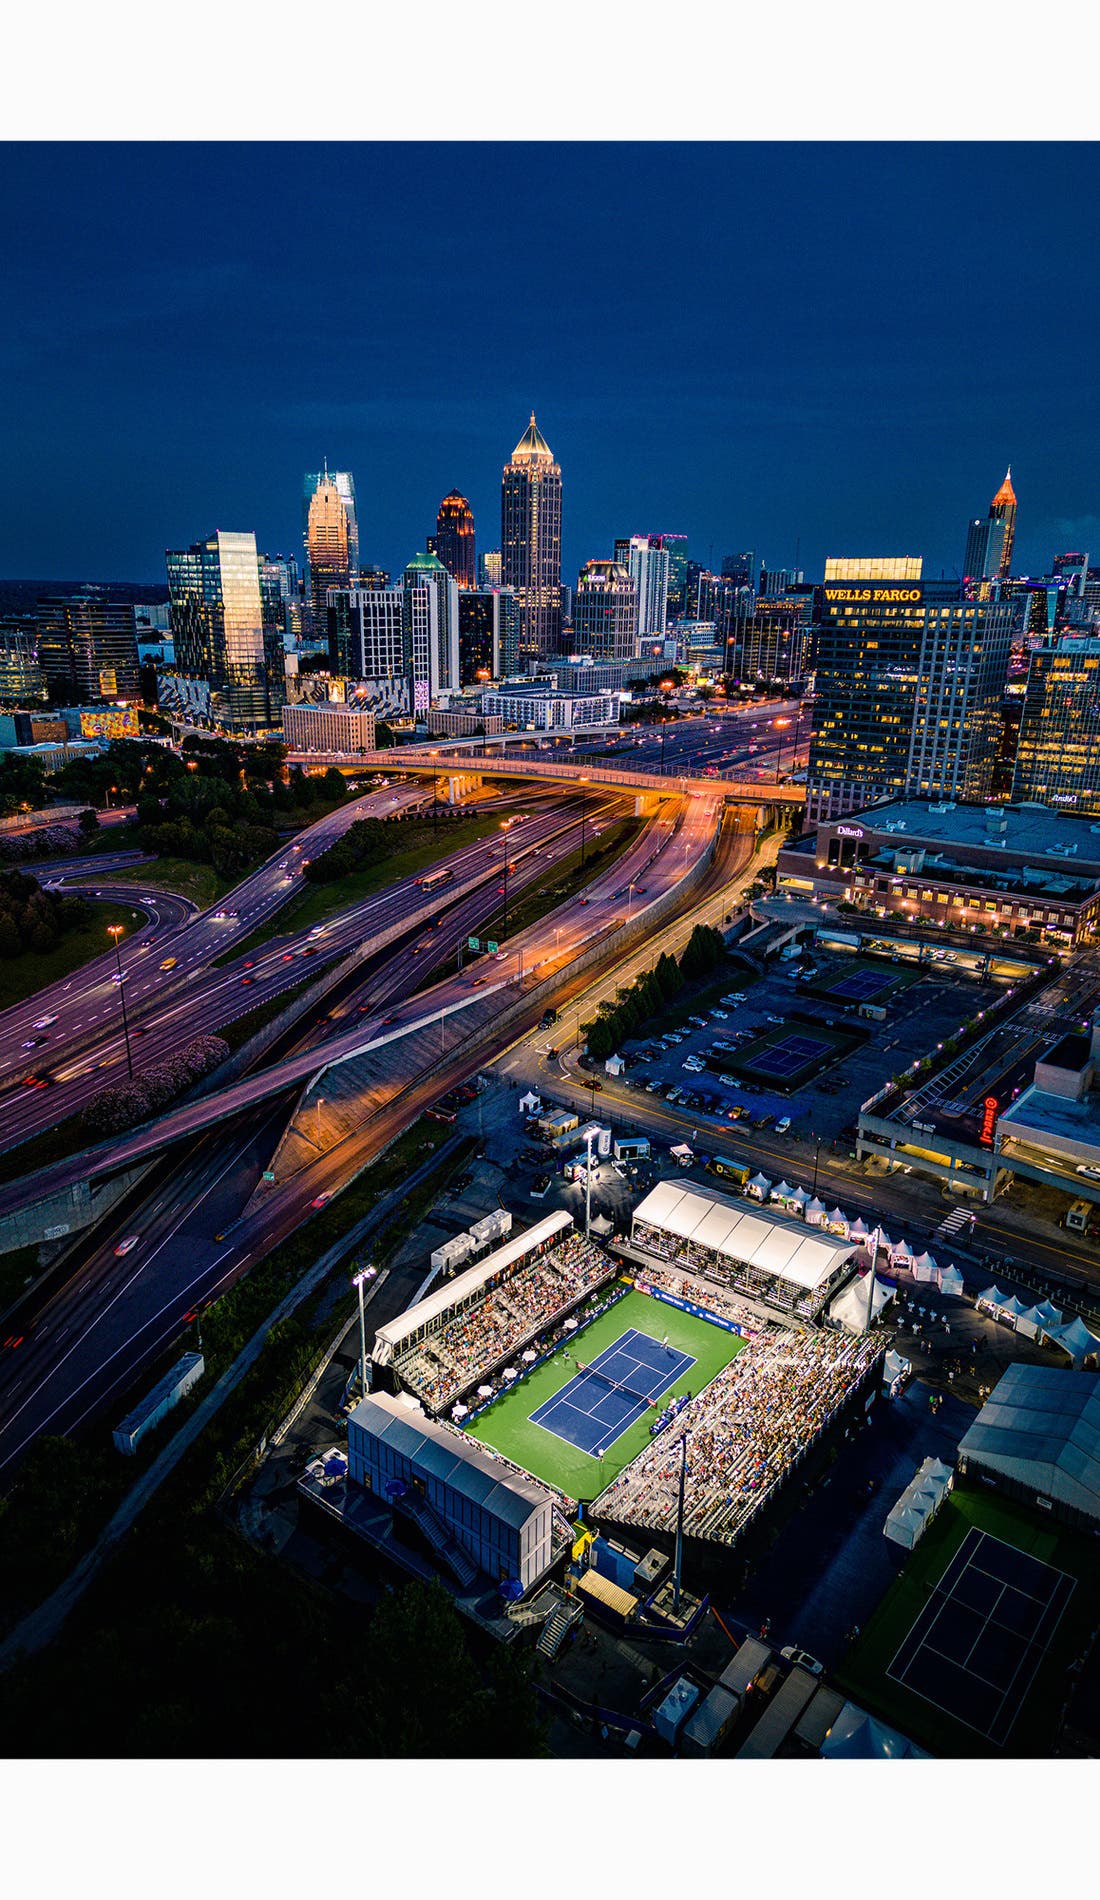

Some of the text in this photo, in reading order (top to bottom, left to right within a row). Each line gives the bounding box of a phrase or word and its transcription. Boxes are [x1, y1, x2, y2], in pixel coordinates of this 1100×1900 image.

[825, 589, 921, 601] WELLS FARGO
[837, 826, 864, 838] Dillard's
